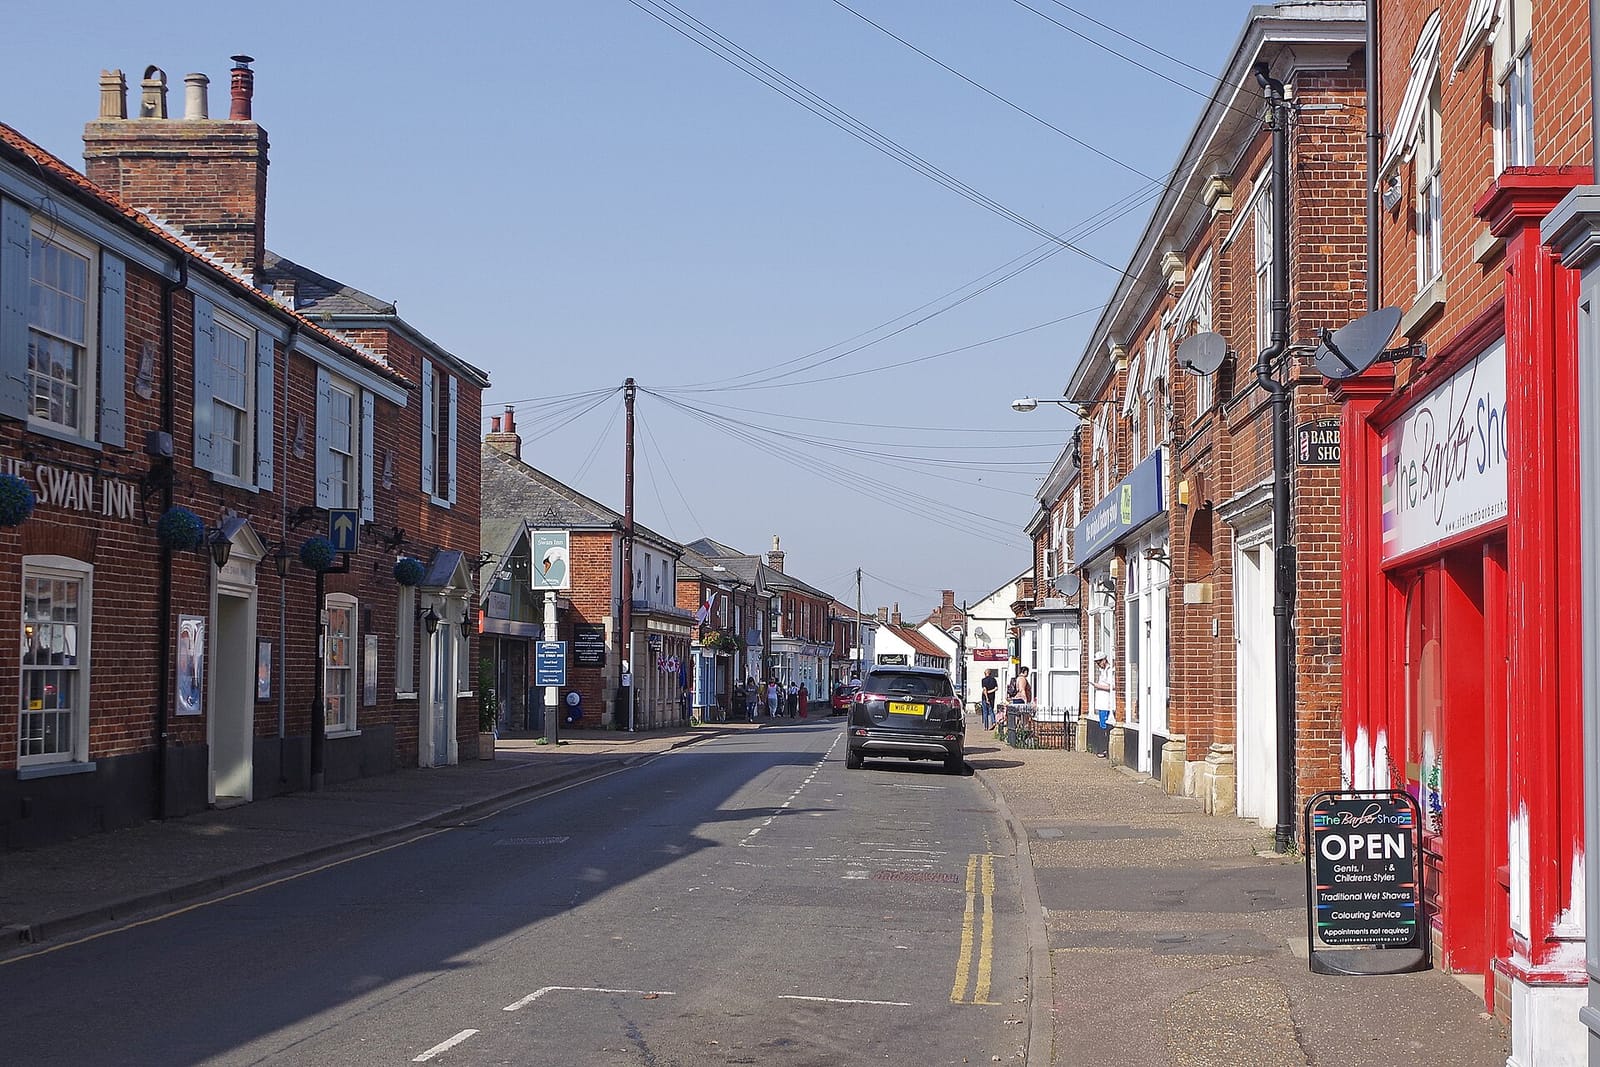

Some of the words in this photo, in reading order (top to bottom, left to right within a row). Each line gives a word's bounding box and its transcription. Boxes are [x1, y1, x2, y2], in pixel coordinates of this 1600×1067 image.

[1310, 430, 1340, 444] BARB
[1394, 452, 1417, 515] The
[1414, 354, 1479, 526] Barber
[1317, 446, 1340, 461] SHO
[35, 464, 93, 513] SWAN
[102, 479, 135, 521] INN
[1321, 815, 1340, 825] The
[1337, 803, 1381, 829] Barber
[1377, 814, 1406, 825] Shop
[1321, 833, 1405, 861] OPEN
[1334, 874, 1371, 883] Childrens
[1372, 873, 1395, 882] Styles
[1321, 892, 1362, 901] Traditional
[1363, 892, 1380, 900] Wet
[1381, 891, 1410, 900] Shaves
[1331, 911, 1370, 920] Colouring
[1371, 910, 1401, 919] Service
[1323, 928, 1369, 936] Appointments
[1381, 927, 1410, 936] required
